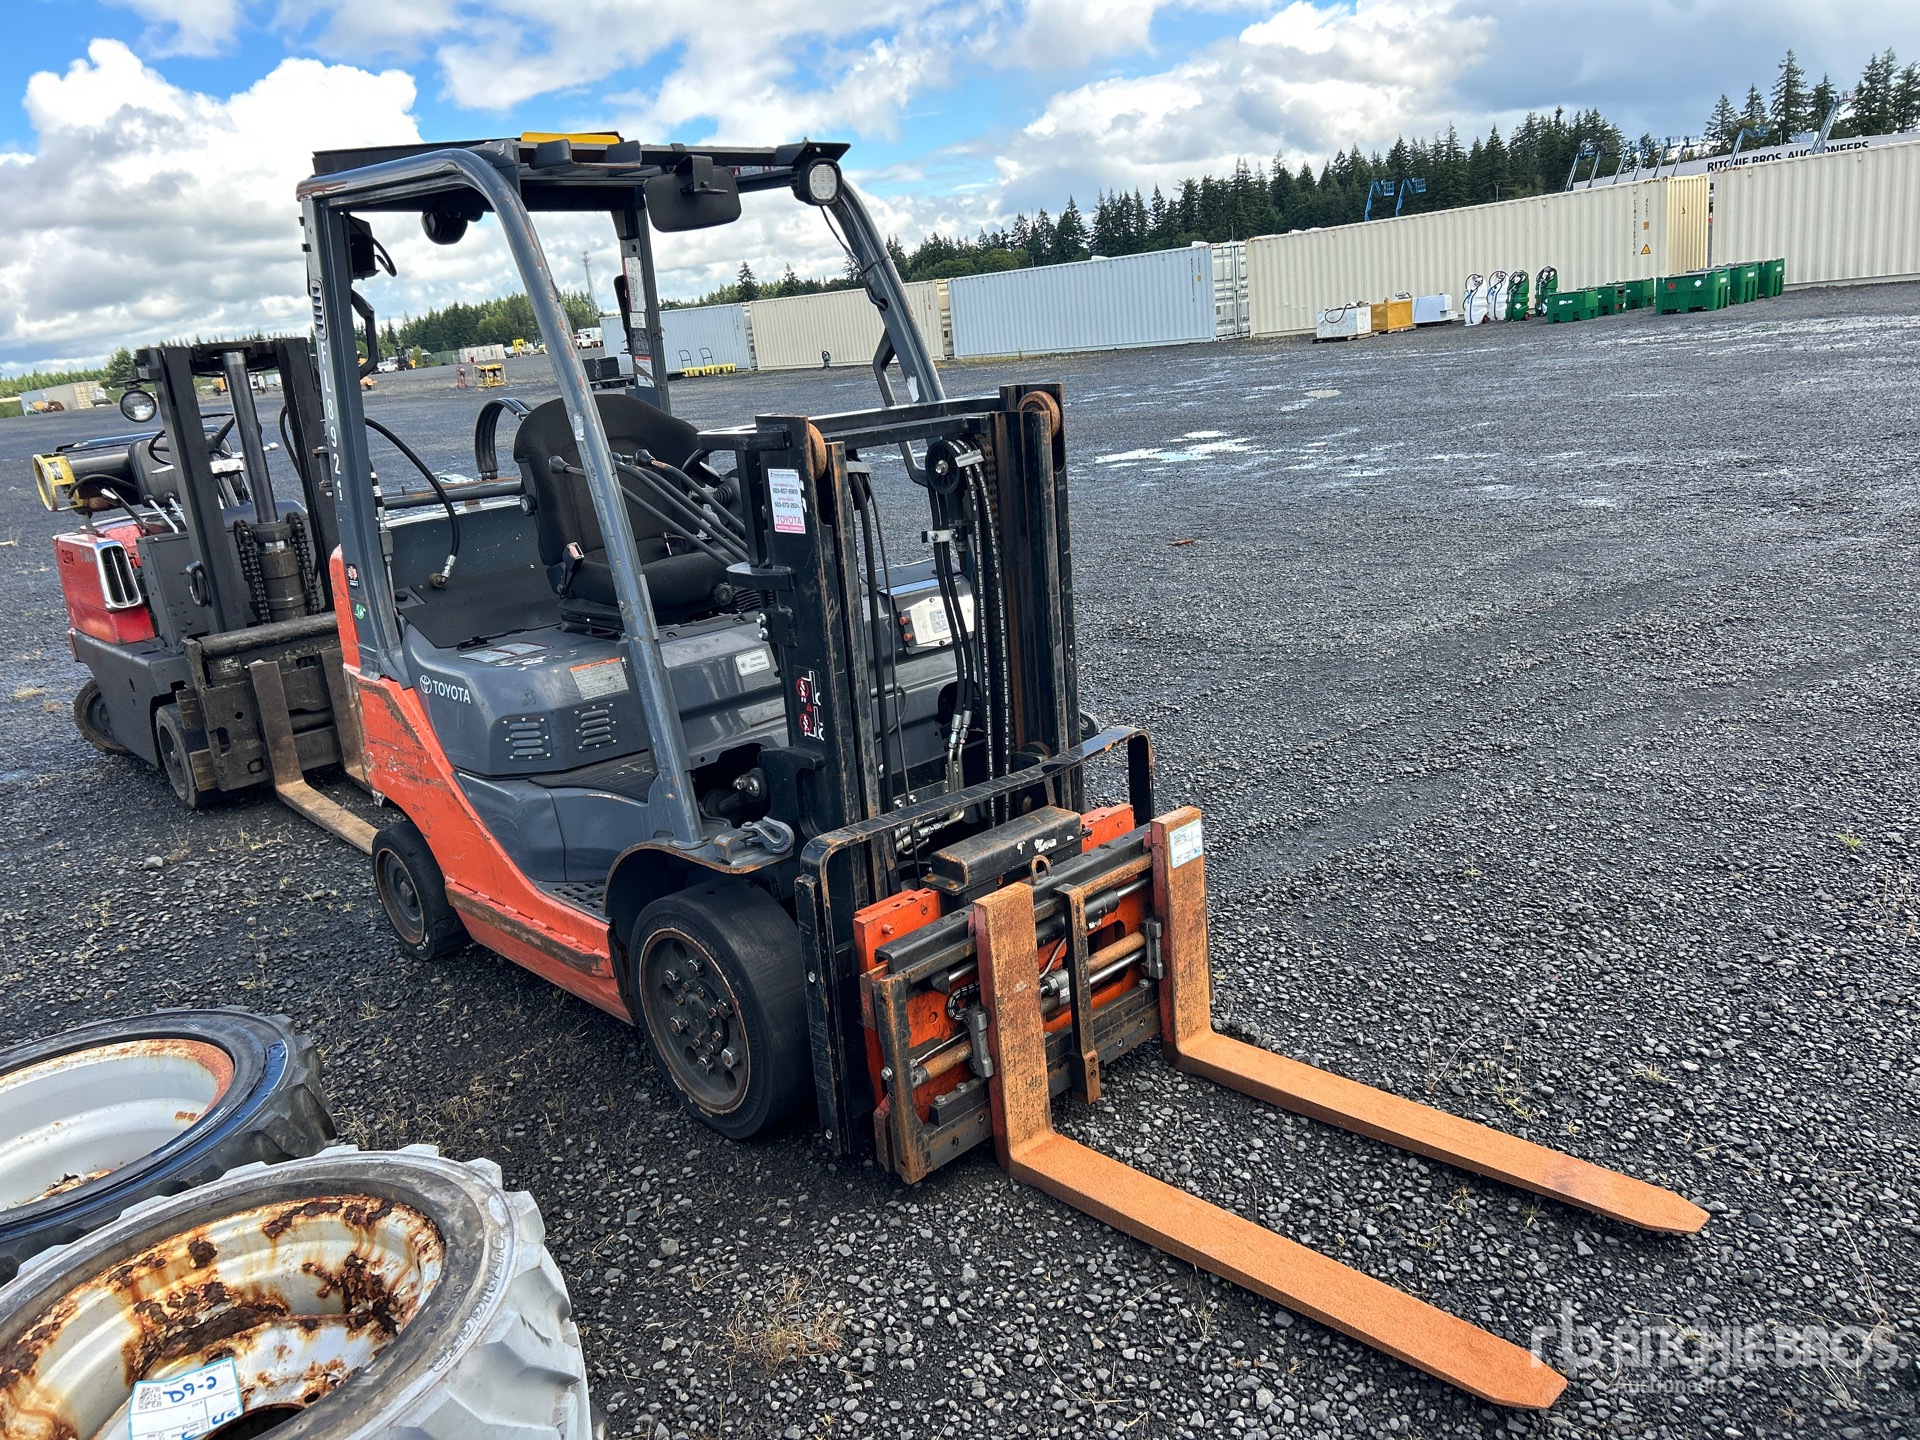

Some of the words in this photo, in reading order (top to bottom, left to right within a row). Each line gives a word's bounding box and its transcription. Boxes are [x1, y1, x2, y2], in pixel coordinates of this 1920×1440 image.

[1787, 140, 1869, 159] AUCONEERS
[776, 515, 802, 525] TOYOTA
[432, 680, 471, 704] TOYOTA
[163, 1375, 217, 1403] D9-2
